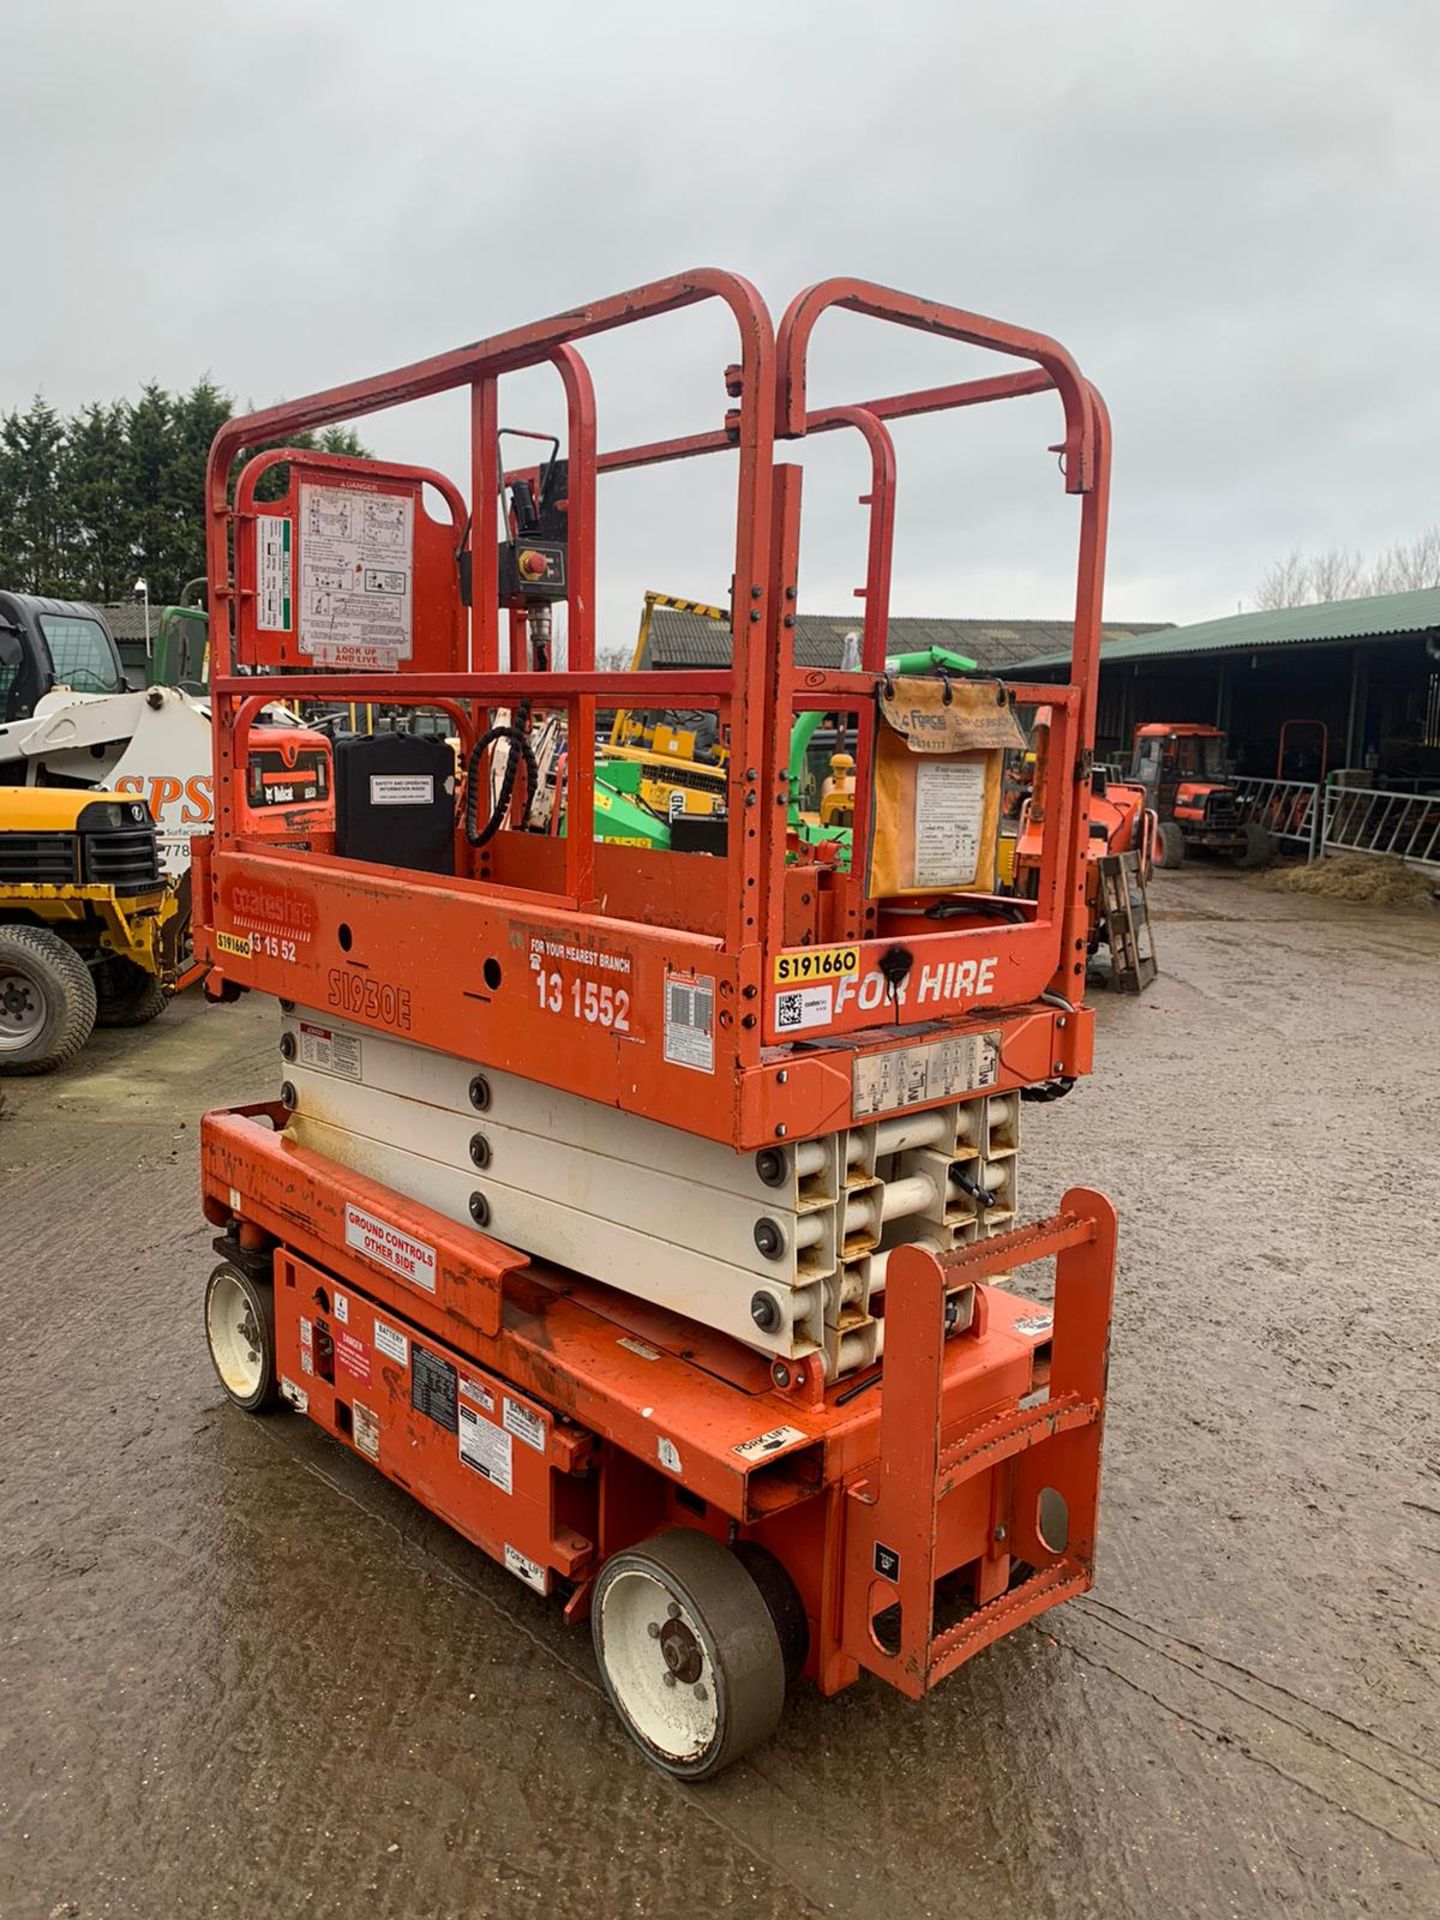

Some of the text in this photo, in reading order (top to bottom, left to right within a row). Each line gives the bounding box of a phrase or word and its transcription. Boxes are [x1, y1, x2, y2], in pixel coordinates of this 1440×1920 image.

[335, 654, 356, 662] AND
[336, 646, 377, 656] LOOK UP
[217, 934, 250, 955] S191660
[248, 931, 296, 962] 13 15 52
[530, 938, 631, 973] FOR YOUR NEAREST BRANCH
[778, 951, 856, 979] S191660
[917, 957, 998, 1004] HIRE
[328, 968, 411, 1031] S1930E
[536, 969, 563, 1013] 13
[571, 978, 630, 1032] 1552
[348, 1212, 434, 1267] GROUND CONTROLS
[364, 1236, 416, 1273] OTHER SIDE
[378, 1324, 403, 1345] BATTERY
[734, 1427, 790, 1453] FORK LIFT
[506, 1547, 545, 1579] FORK LIFT
